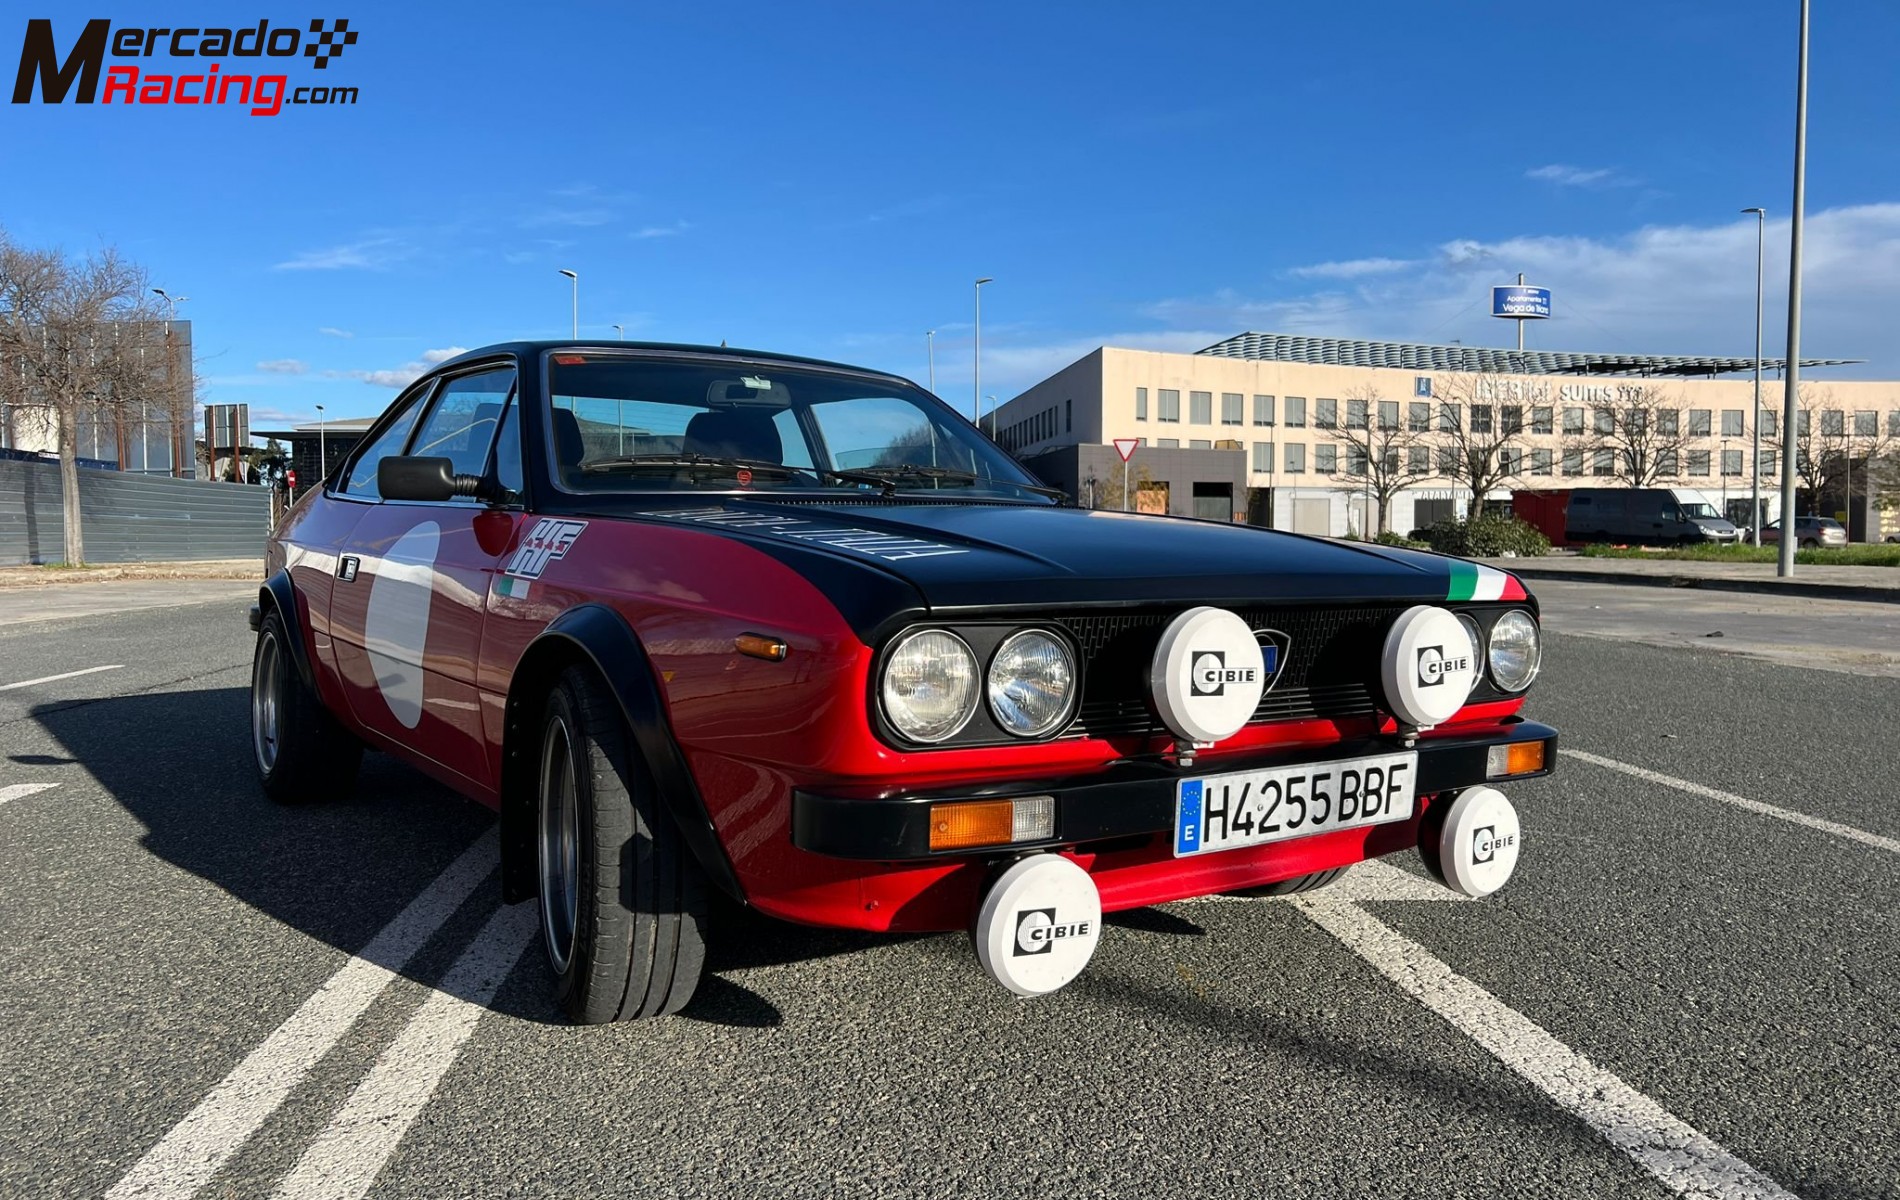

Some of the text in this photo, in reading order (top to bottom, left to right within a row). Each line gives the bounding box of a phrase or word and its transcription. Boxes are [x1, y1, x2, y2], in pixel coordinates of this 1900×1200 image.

[1503, 303, 1525, 313] Vega
[1526, 304, 1535, 312] de
[1560, 384, 1613, 402] SUITES
[505, 518, 589, 579] HF
[1428, 658, 1467, 674] CIBIE
[1205, 670, 1255, 682] CIBIE
[1184, 824, 1195, 841] E
[1481, 835, 1514, 852] CIBIE
[1030, 923, 1089, 941] CIBIE
